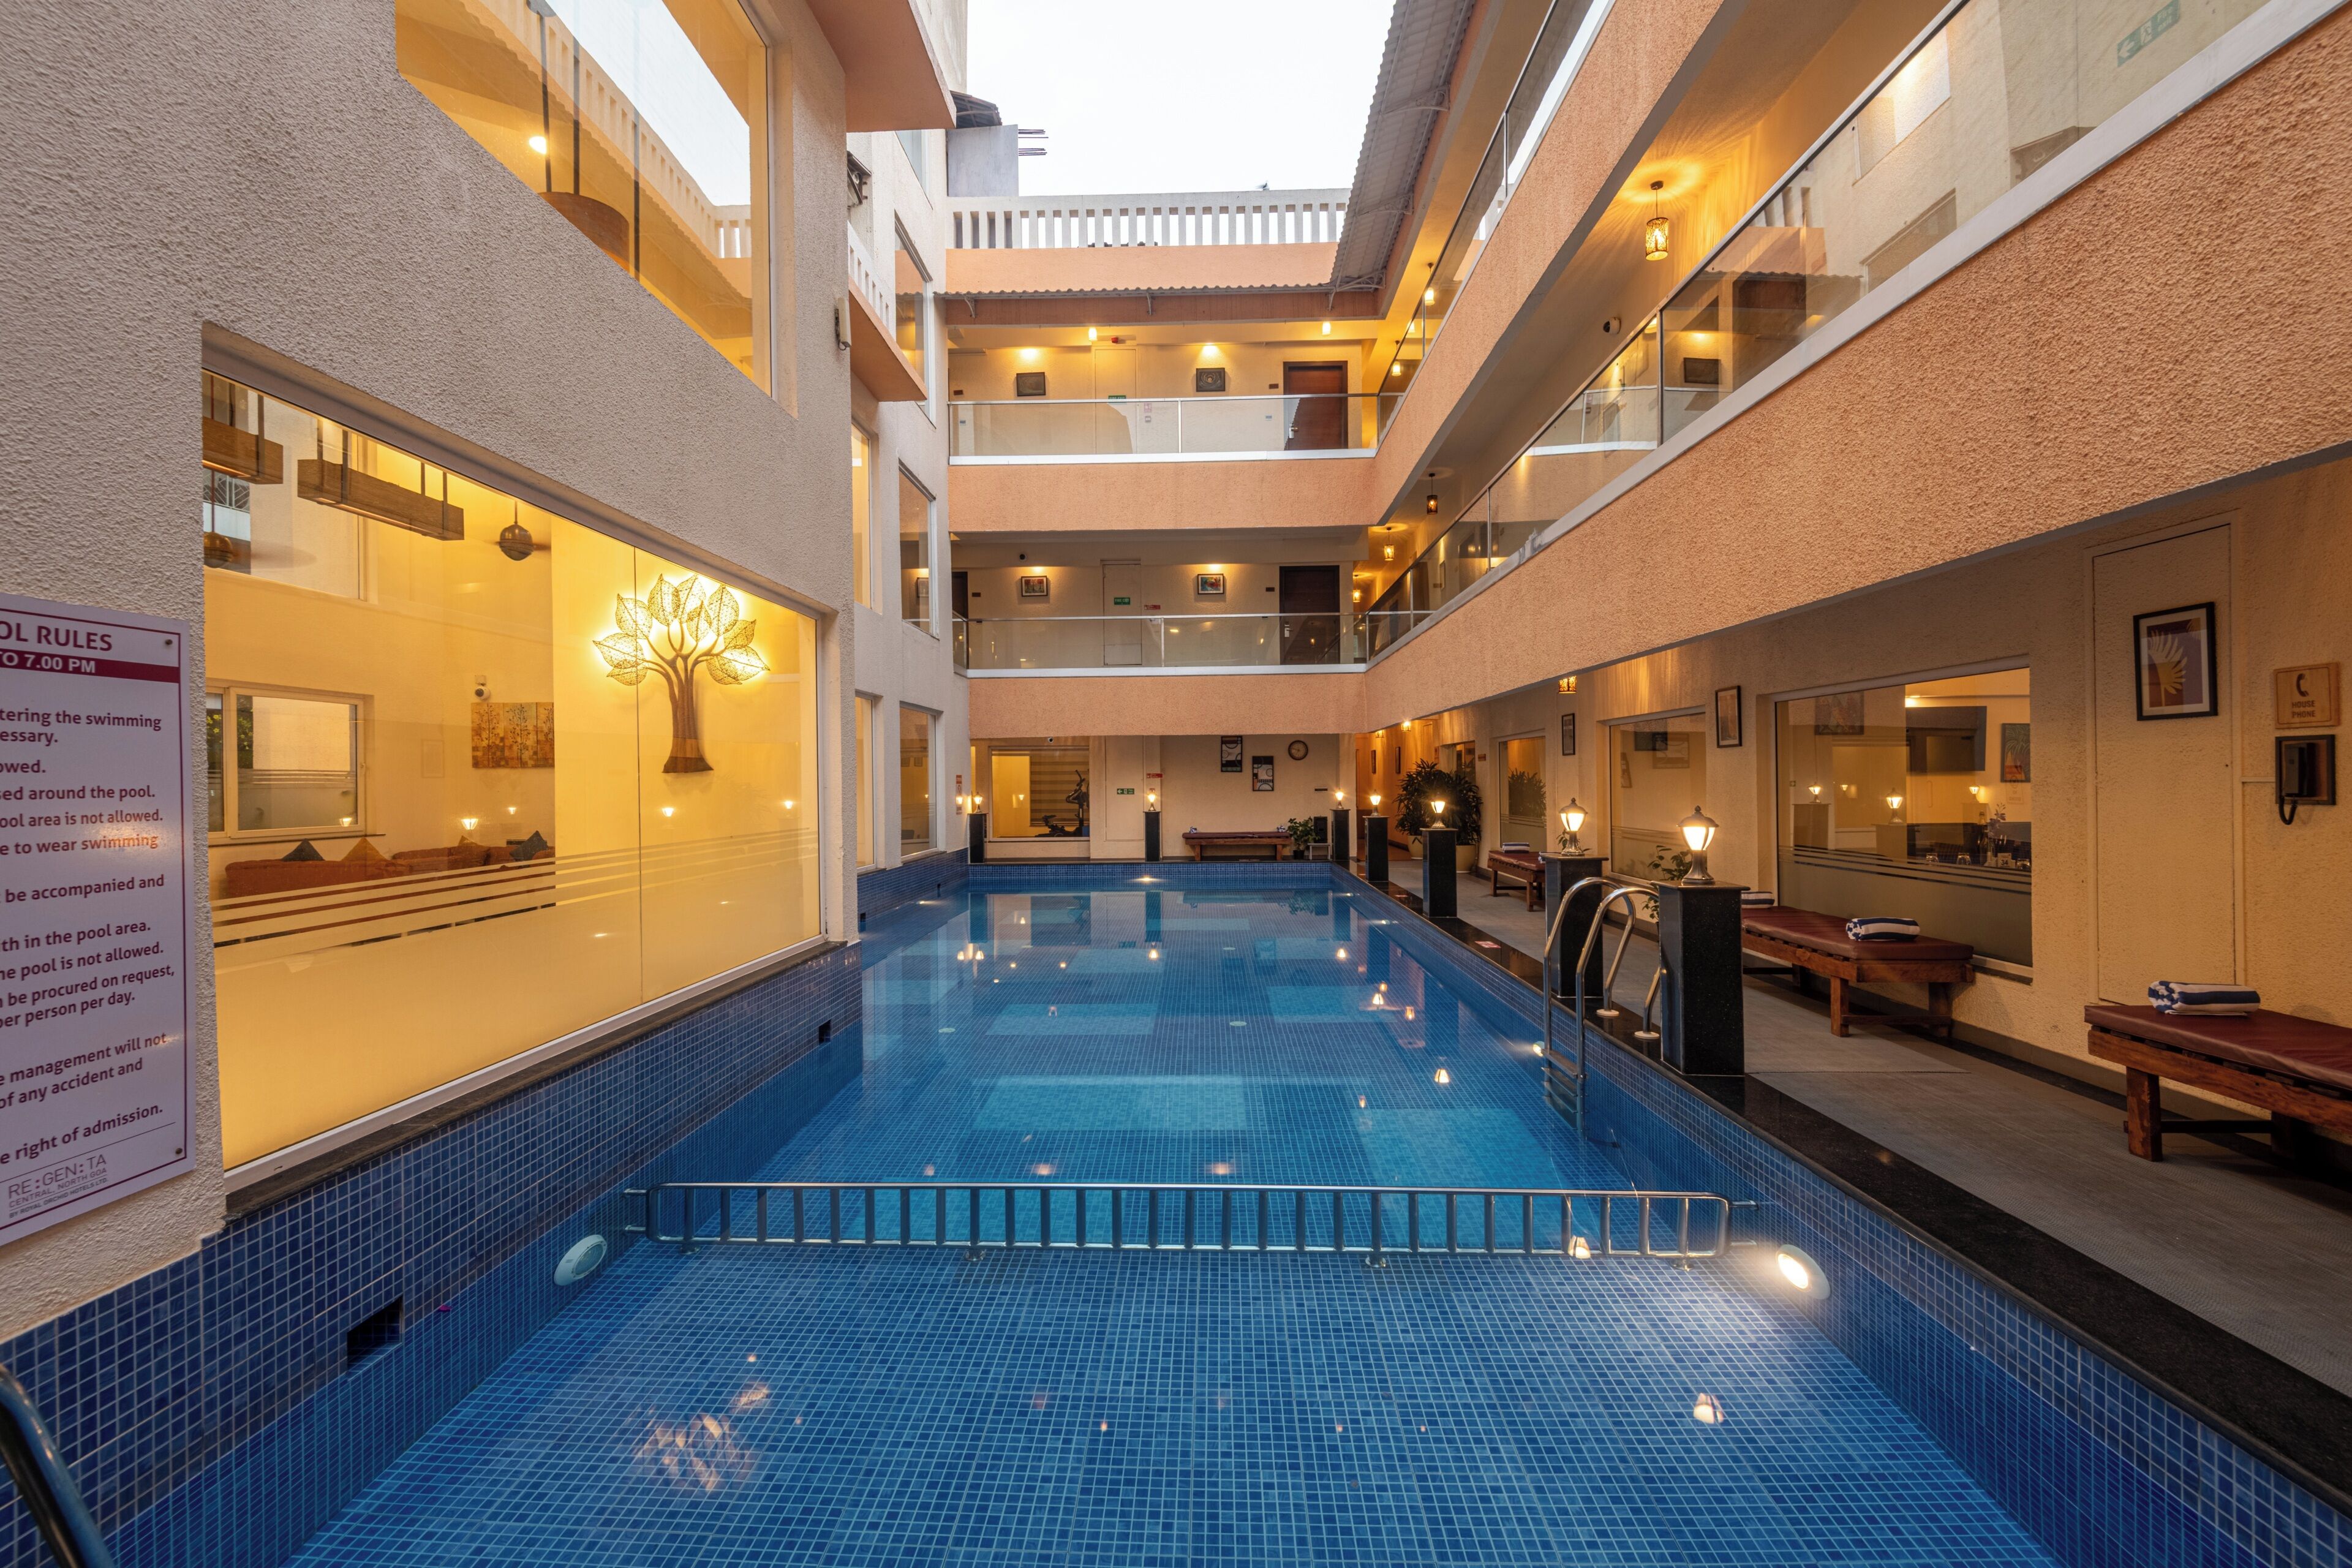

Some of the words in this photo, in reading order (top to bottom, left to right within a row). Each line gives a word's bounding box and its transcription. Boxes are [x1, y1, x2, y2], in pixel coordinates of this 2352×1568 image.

[37, 625, 112, 651] RULES
[0, 651, 19, 666] O
[24, 654, 62, 670] 7.00
[69, 658, 96, 673] PM
[0, 708, 51, 726] tering
[56, 710, 81, 724] the
[86, 712, 162, 731] swimming
[0, 731, 58, 747] essary.
[0, 786, 23, 800] ed
[29, 786, 86, 800] around
[90, 786, 115, 798] the
[119, 785, 156, 802] pool.
[0, 813, 24, 827] ool
[29, 816, 61, 827] area
[65, 812, 77, 825] is
[81, 813, 104, 824] not
[107, 809, 164, 823] allowed.
[14, 842, 32, 854] to
[37, 840, 77, 853] wear
[81, 834, 159, 850] swimming
[5, 889, 26, 903] be
[31, 877, 135, 899] accompanied
[139, 874, 164, 888] and
[1, 937, 20, 952] th
[24, 935, 40, 949] in
[45, 931, 73, 945] the
[77, 924, 112, 944] pool
[115, 922, 151, 935] area.
[21, 958, 57, 981] pool
[61, 957, 73, 970] is
[77, 952, 102, 967] not
[105, 941, 164, 962] allowed.
[8, 992, 27, 1006] be
[32, 977, 97, 1005] procured
[101, 976, 118, 988] on
[123, 965, 175, 984] request,
[25, 1003, 77, 1027] person
[81, 997, 104, 1015] per
[108, 992, 135, 1005] day.
[10, 1046, 111, 1083] management
[115, 1037, 141, 1055] will
[145, 1033, 167, 1048] not
[18, 1086, 48, 1103] any
[51, 1066, 115, 1094] accident
[118, 1057, 143, 1076] and
[15, 1136, 58, 1159] right
[62, 1126, 80, 1144] of
[83, 1104, 163, 1137] admission.
[58, 1174, 88, 1190] NORTH
[90, 1167, 107, 1178] GOA
[20, 1203, 42, 1214] ROYAL
[43, 1192, 69, 1205] ORCHID
[70, 1182, 94, 1195] HOTELS
